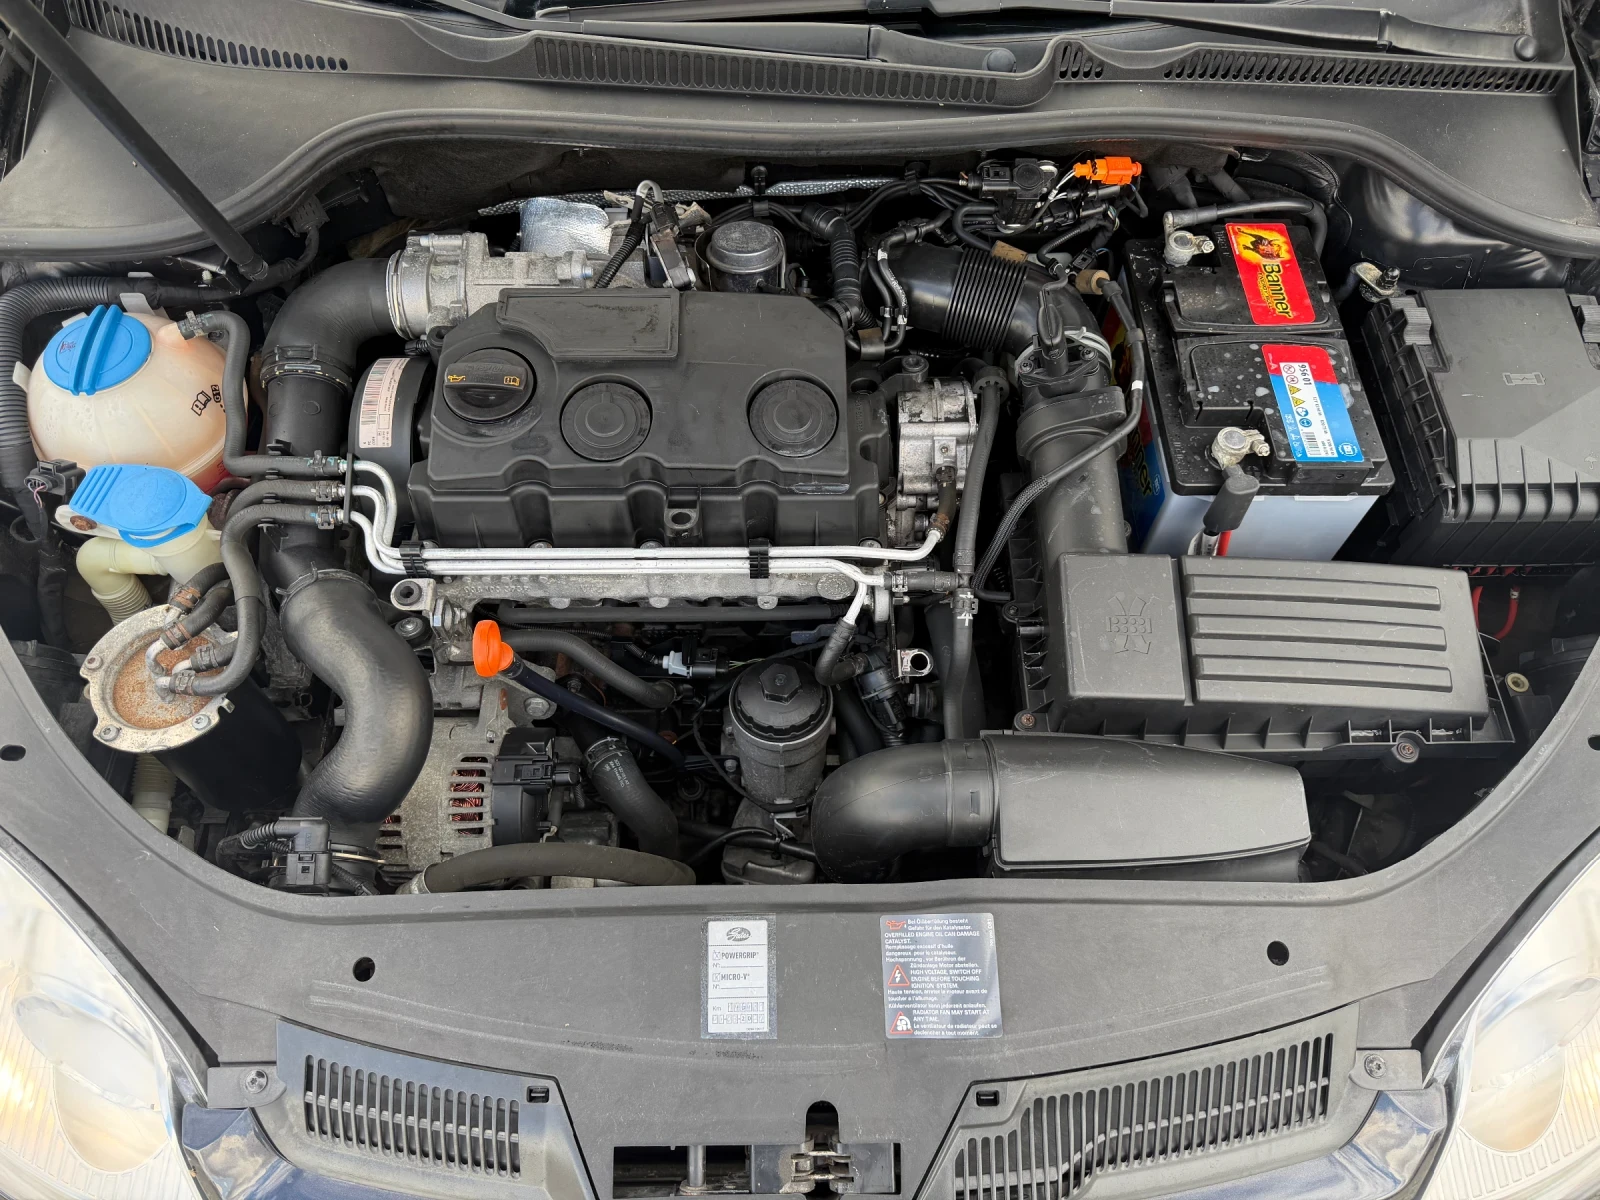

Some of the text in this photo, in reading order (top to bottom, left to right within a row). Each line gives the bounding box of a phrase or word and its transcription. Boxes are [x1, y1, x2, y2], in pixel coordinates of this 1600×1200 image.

[1262, 263, 1292, 318] Banner
[1298, 364, 1312, 386] 956 01
[211, 385, 221, 402] G12
